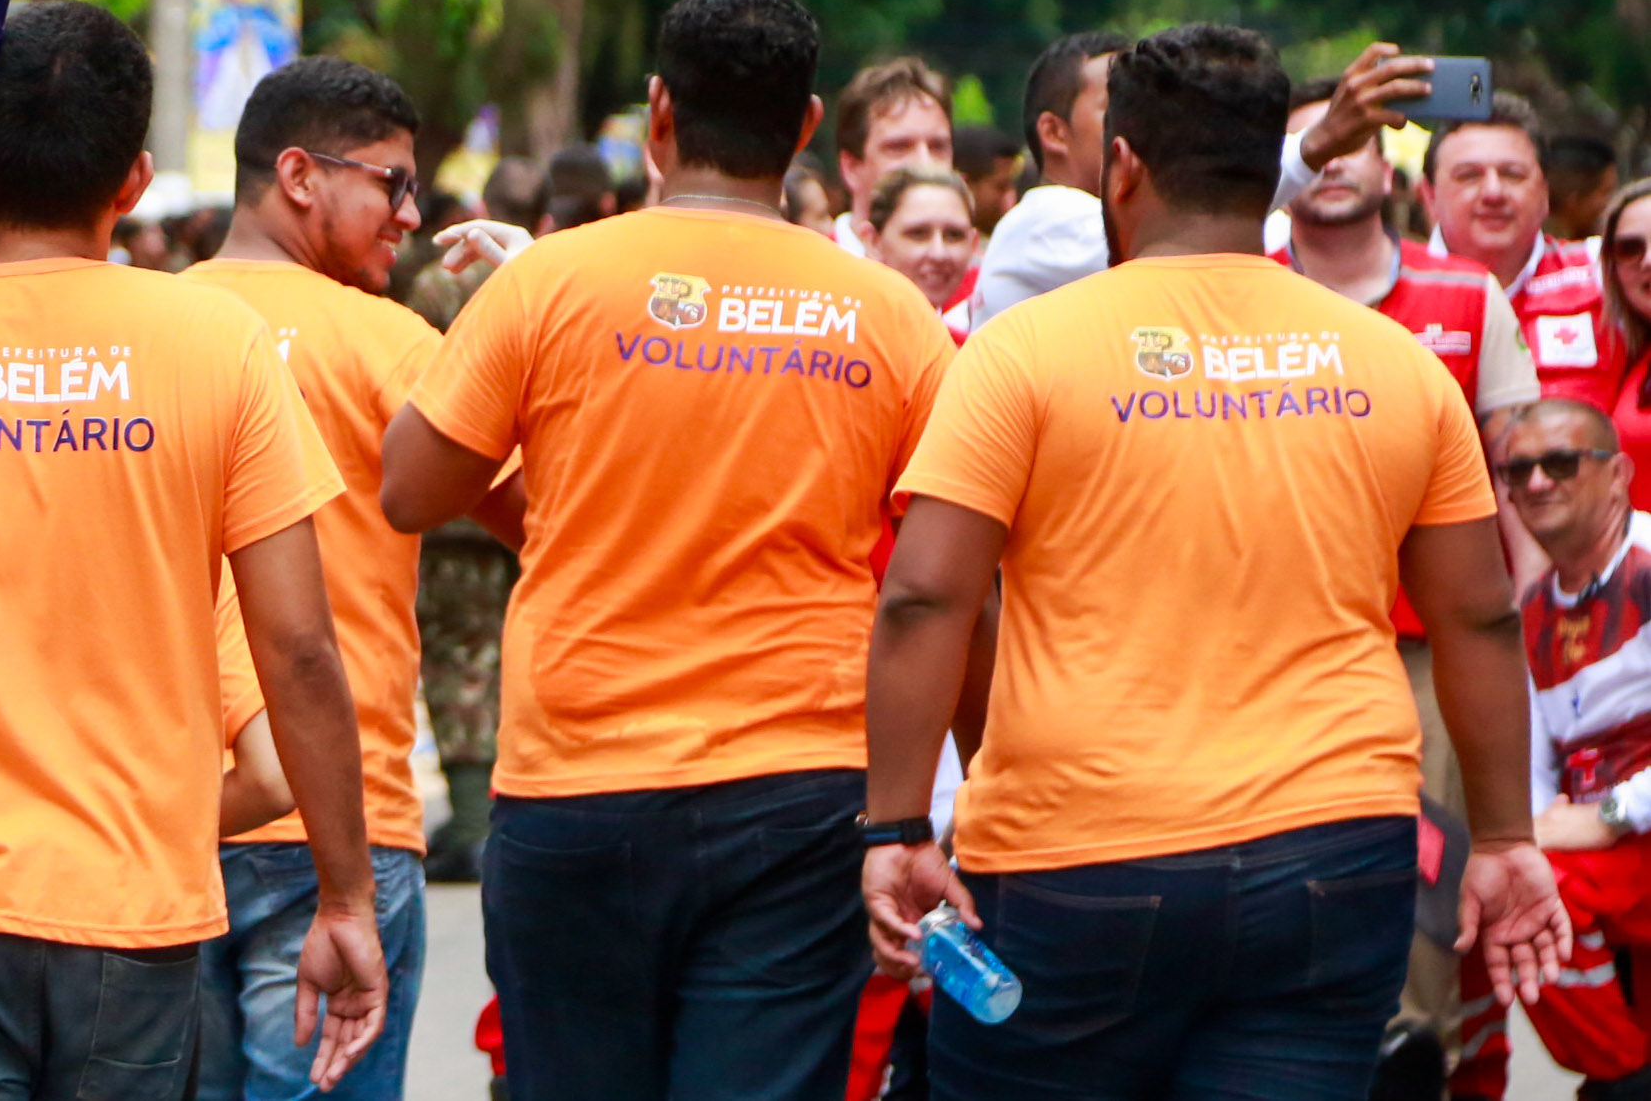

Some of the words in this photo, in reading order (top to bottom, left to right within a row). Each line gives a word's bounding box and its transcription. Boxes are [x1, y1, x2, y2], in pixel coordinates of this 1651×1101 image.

[721, 285, 833, 301] PREFEITURA
[843, 296, 862, 308] DE
[717, 297, 858, 343] BELÉM
[110, 346, 131, 358] DE
[615, 332, 873, 389] VOLUNTÁRIO
[1203, 342, 1345, 381] BELÉM
[1111, 383, 1372, 423] VOLUNTÁRIO
